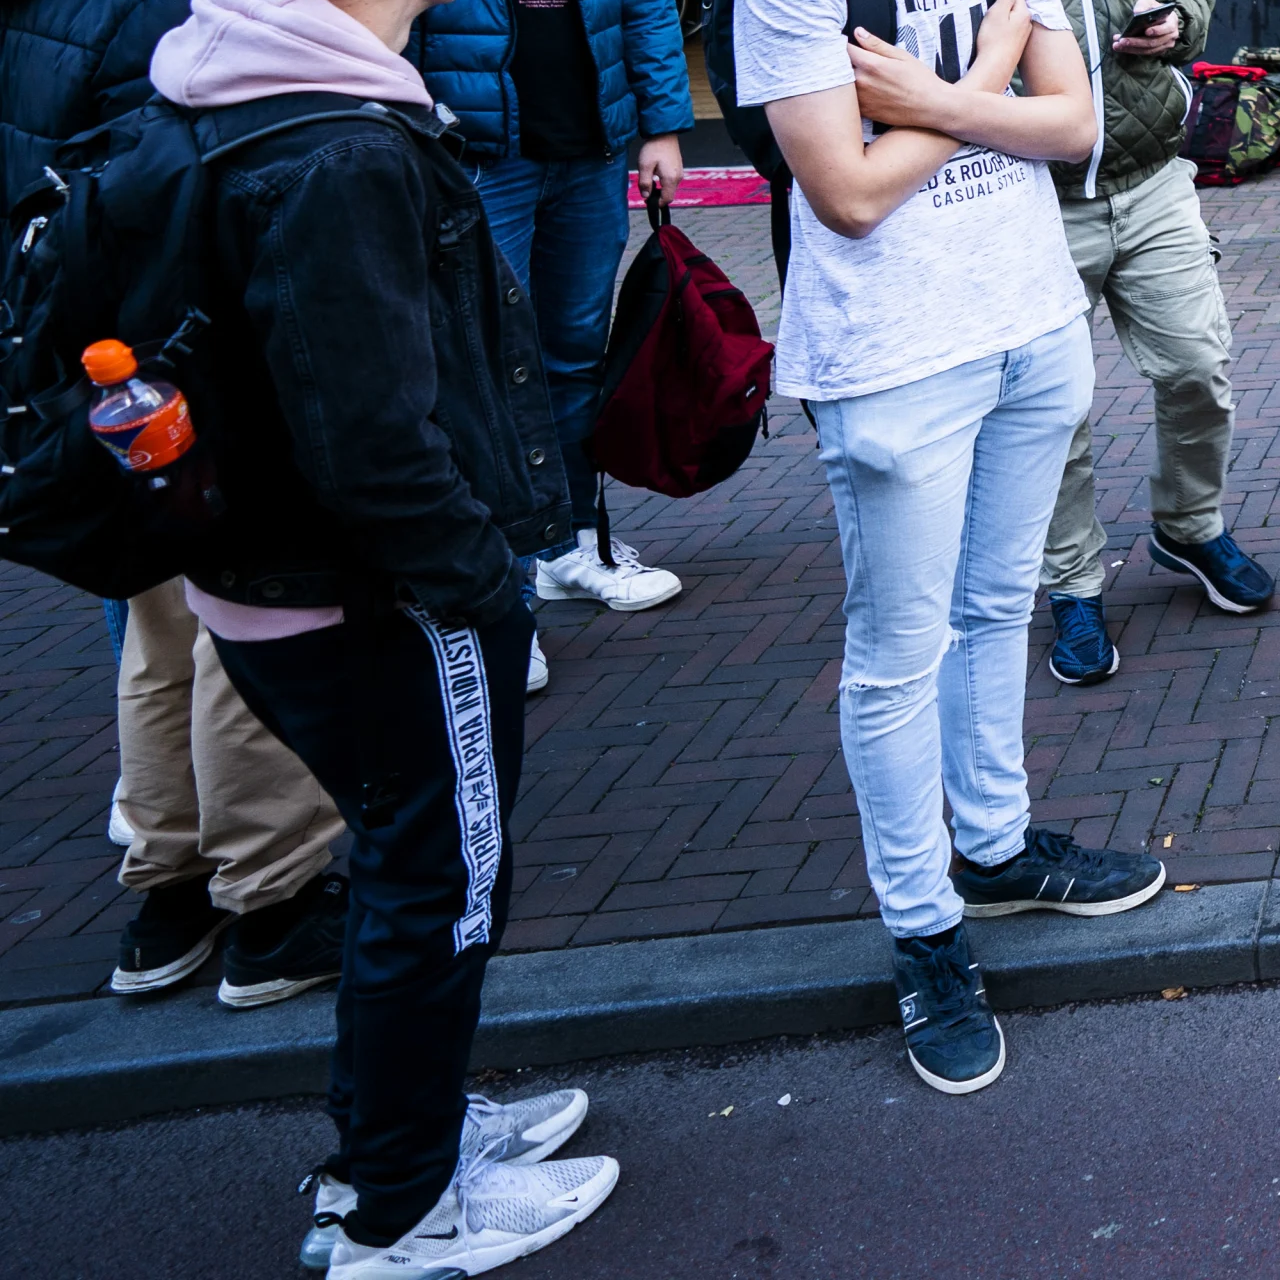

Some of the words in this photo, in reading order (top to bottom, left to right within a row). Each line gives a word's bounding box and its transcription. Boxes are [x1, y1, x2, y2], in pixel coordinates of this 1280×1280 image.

[932, 180, 994, 208] CASUAL
[997, 167, 1026, 191] STYLE
[458, 713, 489, 783] ALPHA
